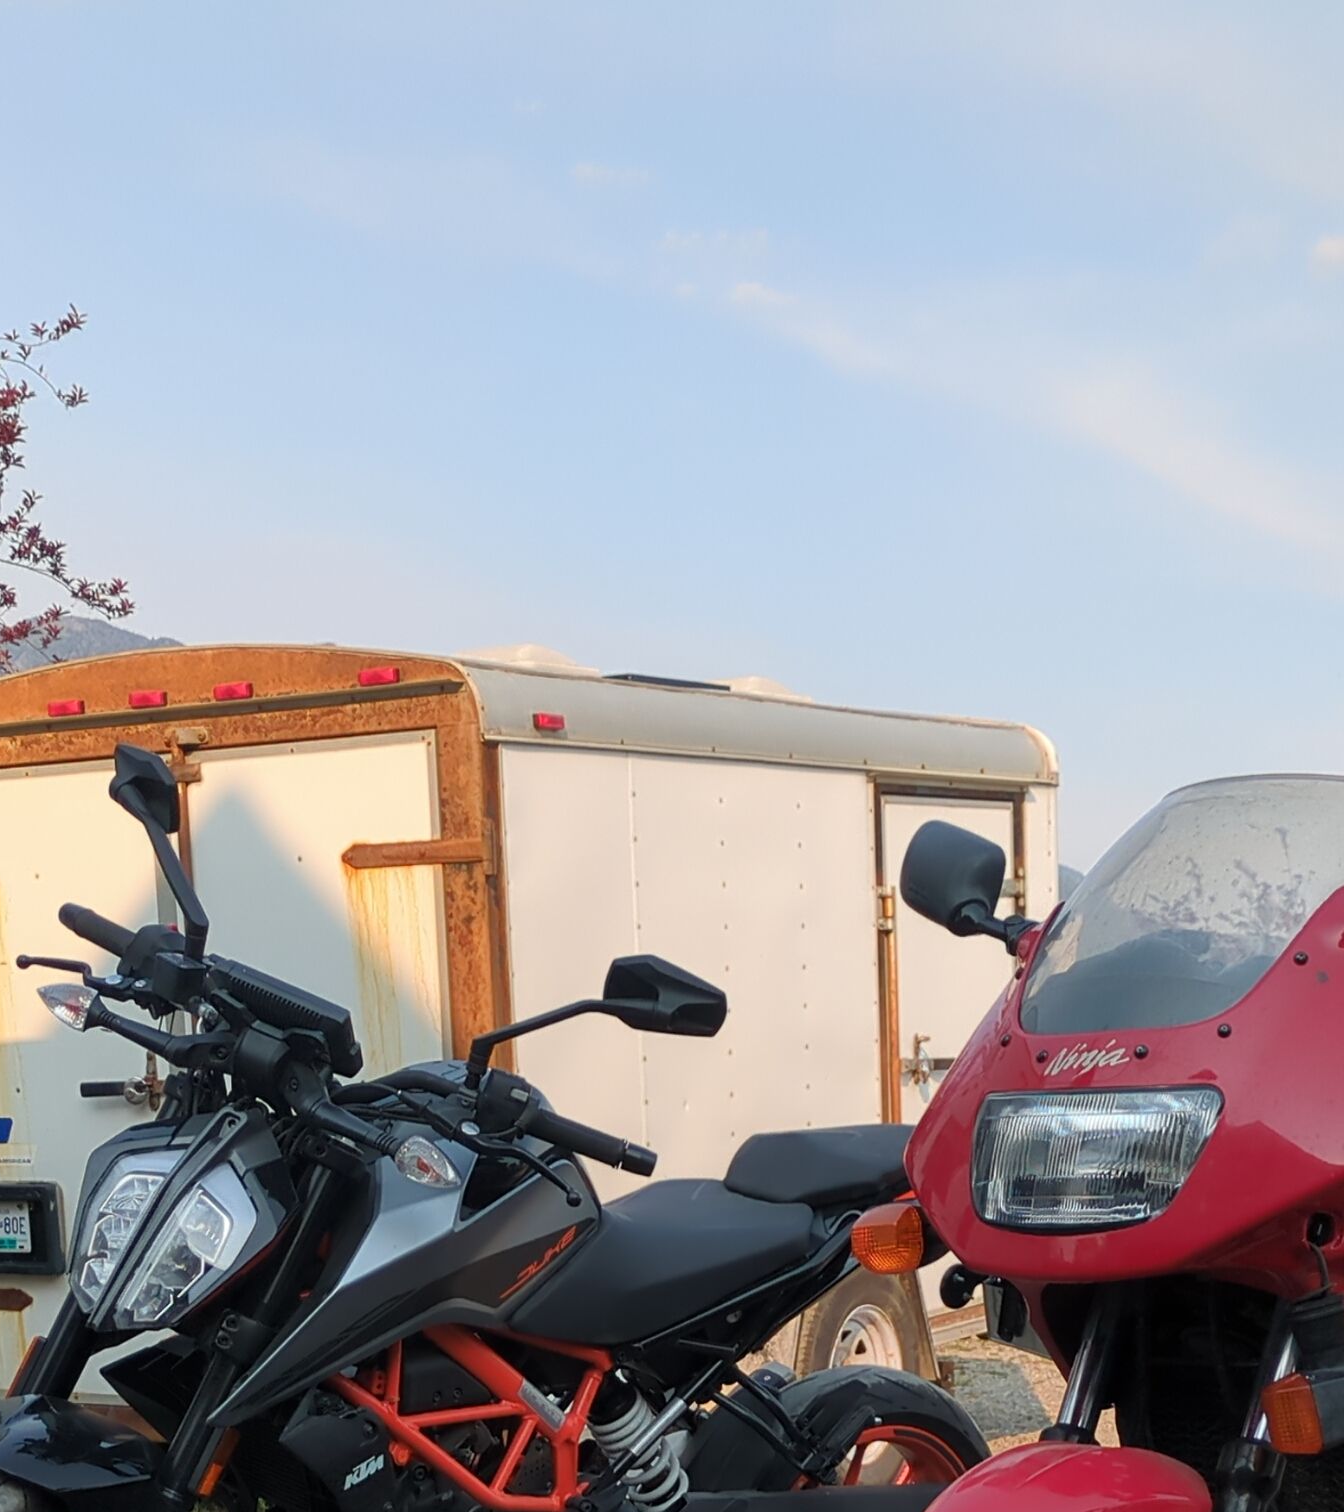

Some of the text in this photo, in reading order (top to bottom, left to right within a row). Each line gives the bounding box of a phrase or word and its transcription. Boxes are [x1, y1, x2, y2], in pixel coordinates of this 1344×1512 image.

[1043, 1038, 1130, 1080] Ninja
[499, 1224, 577, 1299] DUKE
[343, 1453, 385, 1491] KTM
